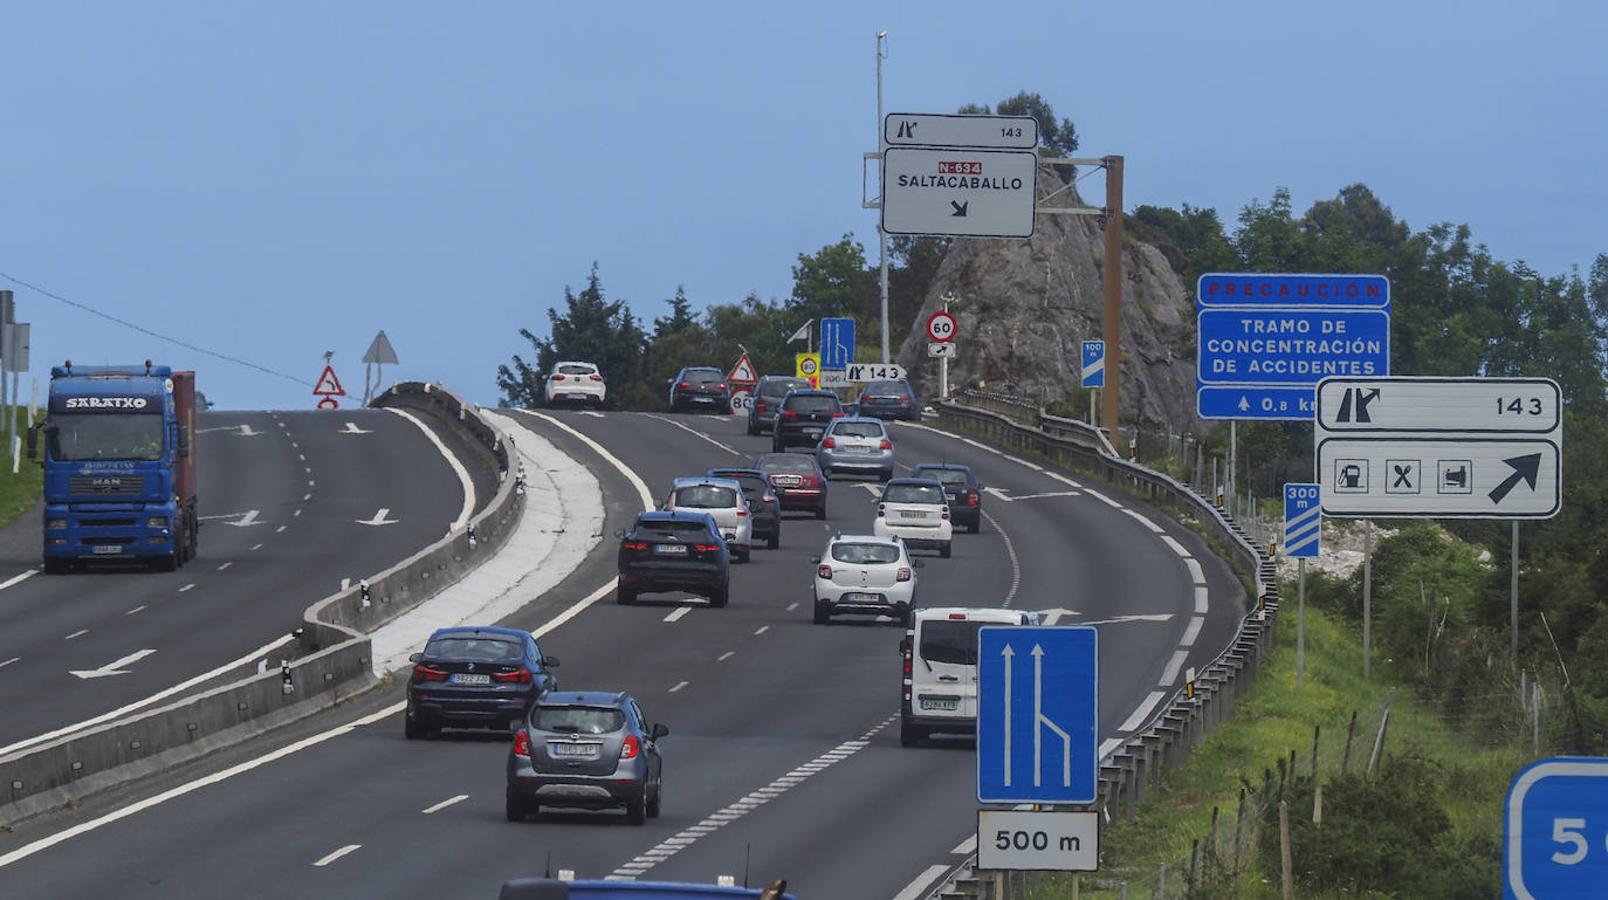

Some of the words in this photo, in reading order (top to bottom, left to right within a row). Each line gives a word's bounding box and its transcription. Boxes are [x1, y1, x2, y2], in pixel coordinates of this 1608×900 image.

[1001, 128, 1022, 138] 143
[939, 162, 982, 173] N-634
[898, 175, 1023, 190] SALTACABALLO
[933, 323, 951, 333] 60
[1241, 320, 1310, 333] TRAMO
[1322, 320, 1346, 333] DE
[1085, 343, 1102, 351] 100
[1207, 337, 1381, 354] CONCENTRACIÓN
[870, 367, 899, 380] 143
[1213, 359, 1237, 373] DE
[1248, 359, 1376, 375] ACCIDENTES
[66, 397, 147, 409] SARATXO
[1496, 397, 1543, 415] 143
[1288, 487, 1317, 499] 300
[1296, 500, 1308, 508] m
[996, 830, 1048, 851] 500
[1059, 836, 1080, 851] m
[1551, 818, 1608, 866] 5
